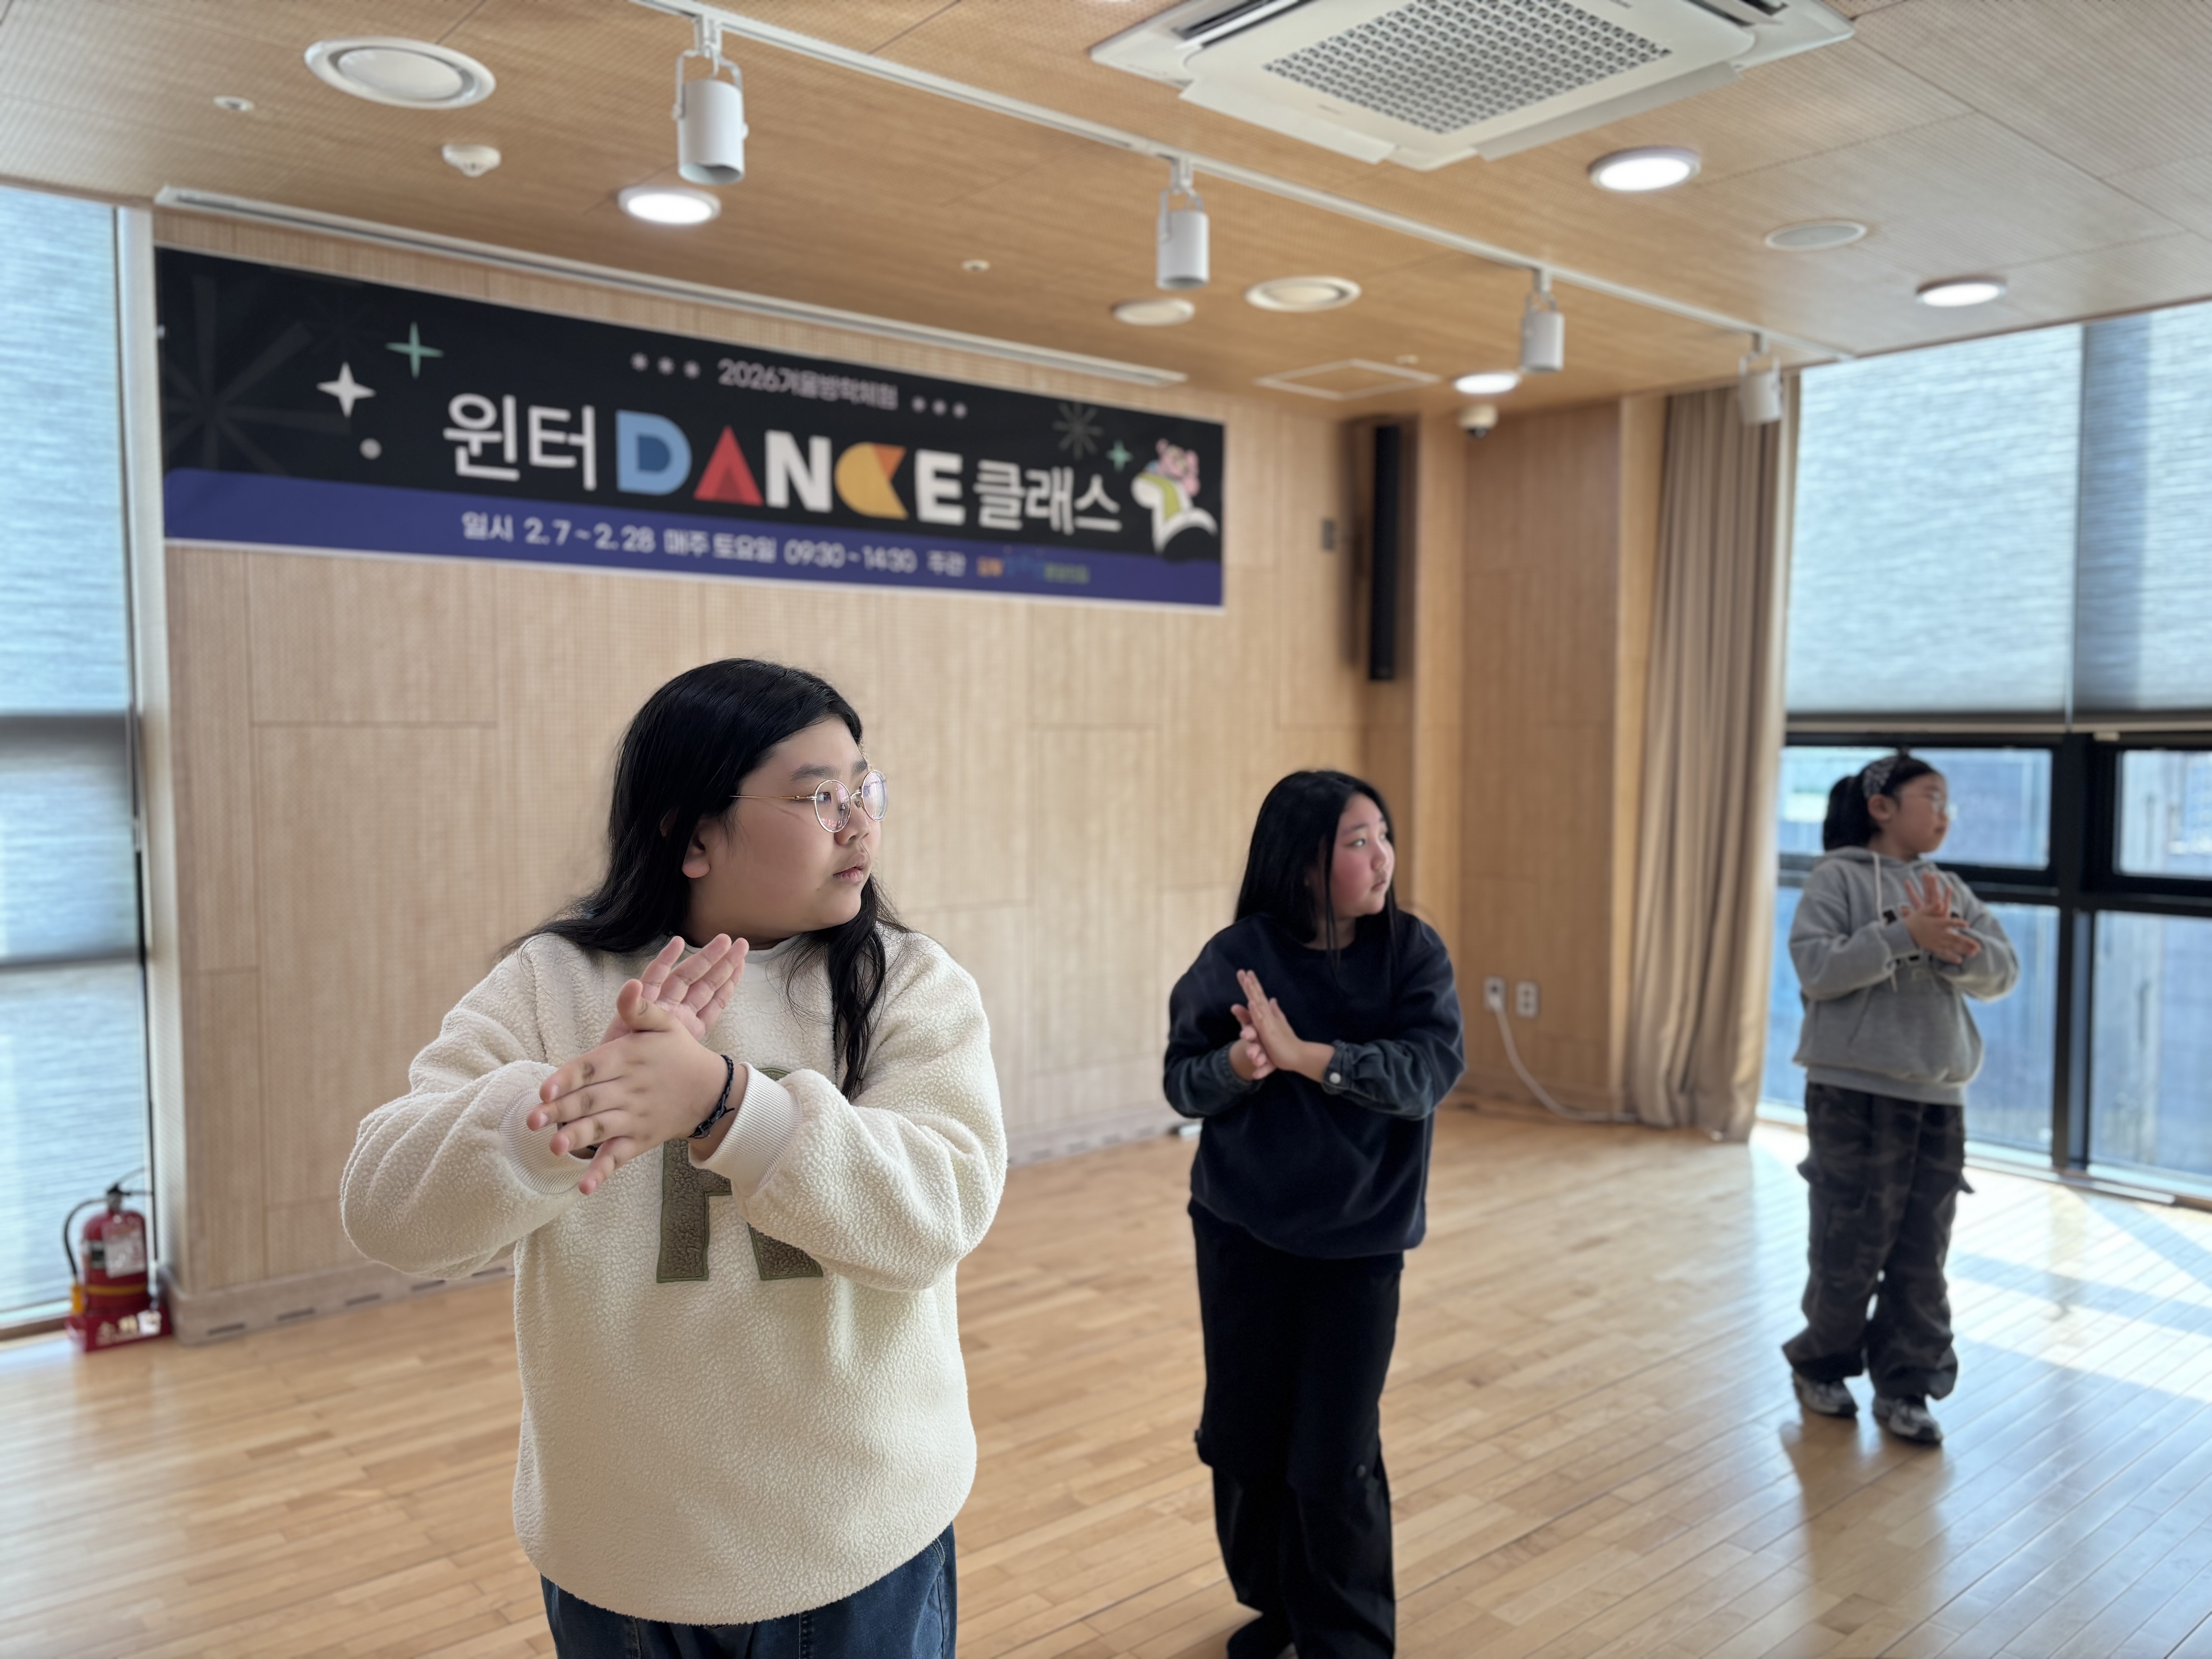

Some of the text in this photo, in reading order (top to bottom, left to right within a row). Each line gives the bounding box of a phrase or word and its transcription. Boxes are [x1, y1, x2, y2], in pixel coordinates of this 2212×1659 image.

[443, 393, 1122, 535] 윈터 DANCE 클래스
[462, 511, 514, 542] 일시
[663, 528, 709, 558] 매주
[712, 533, 777, 563] 토요일
